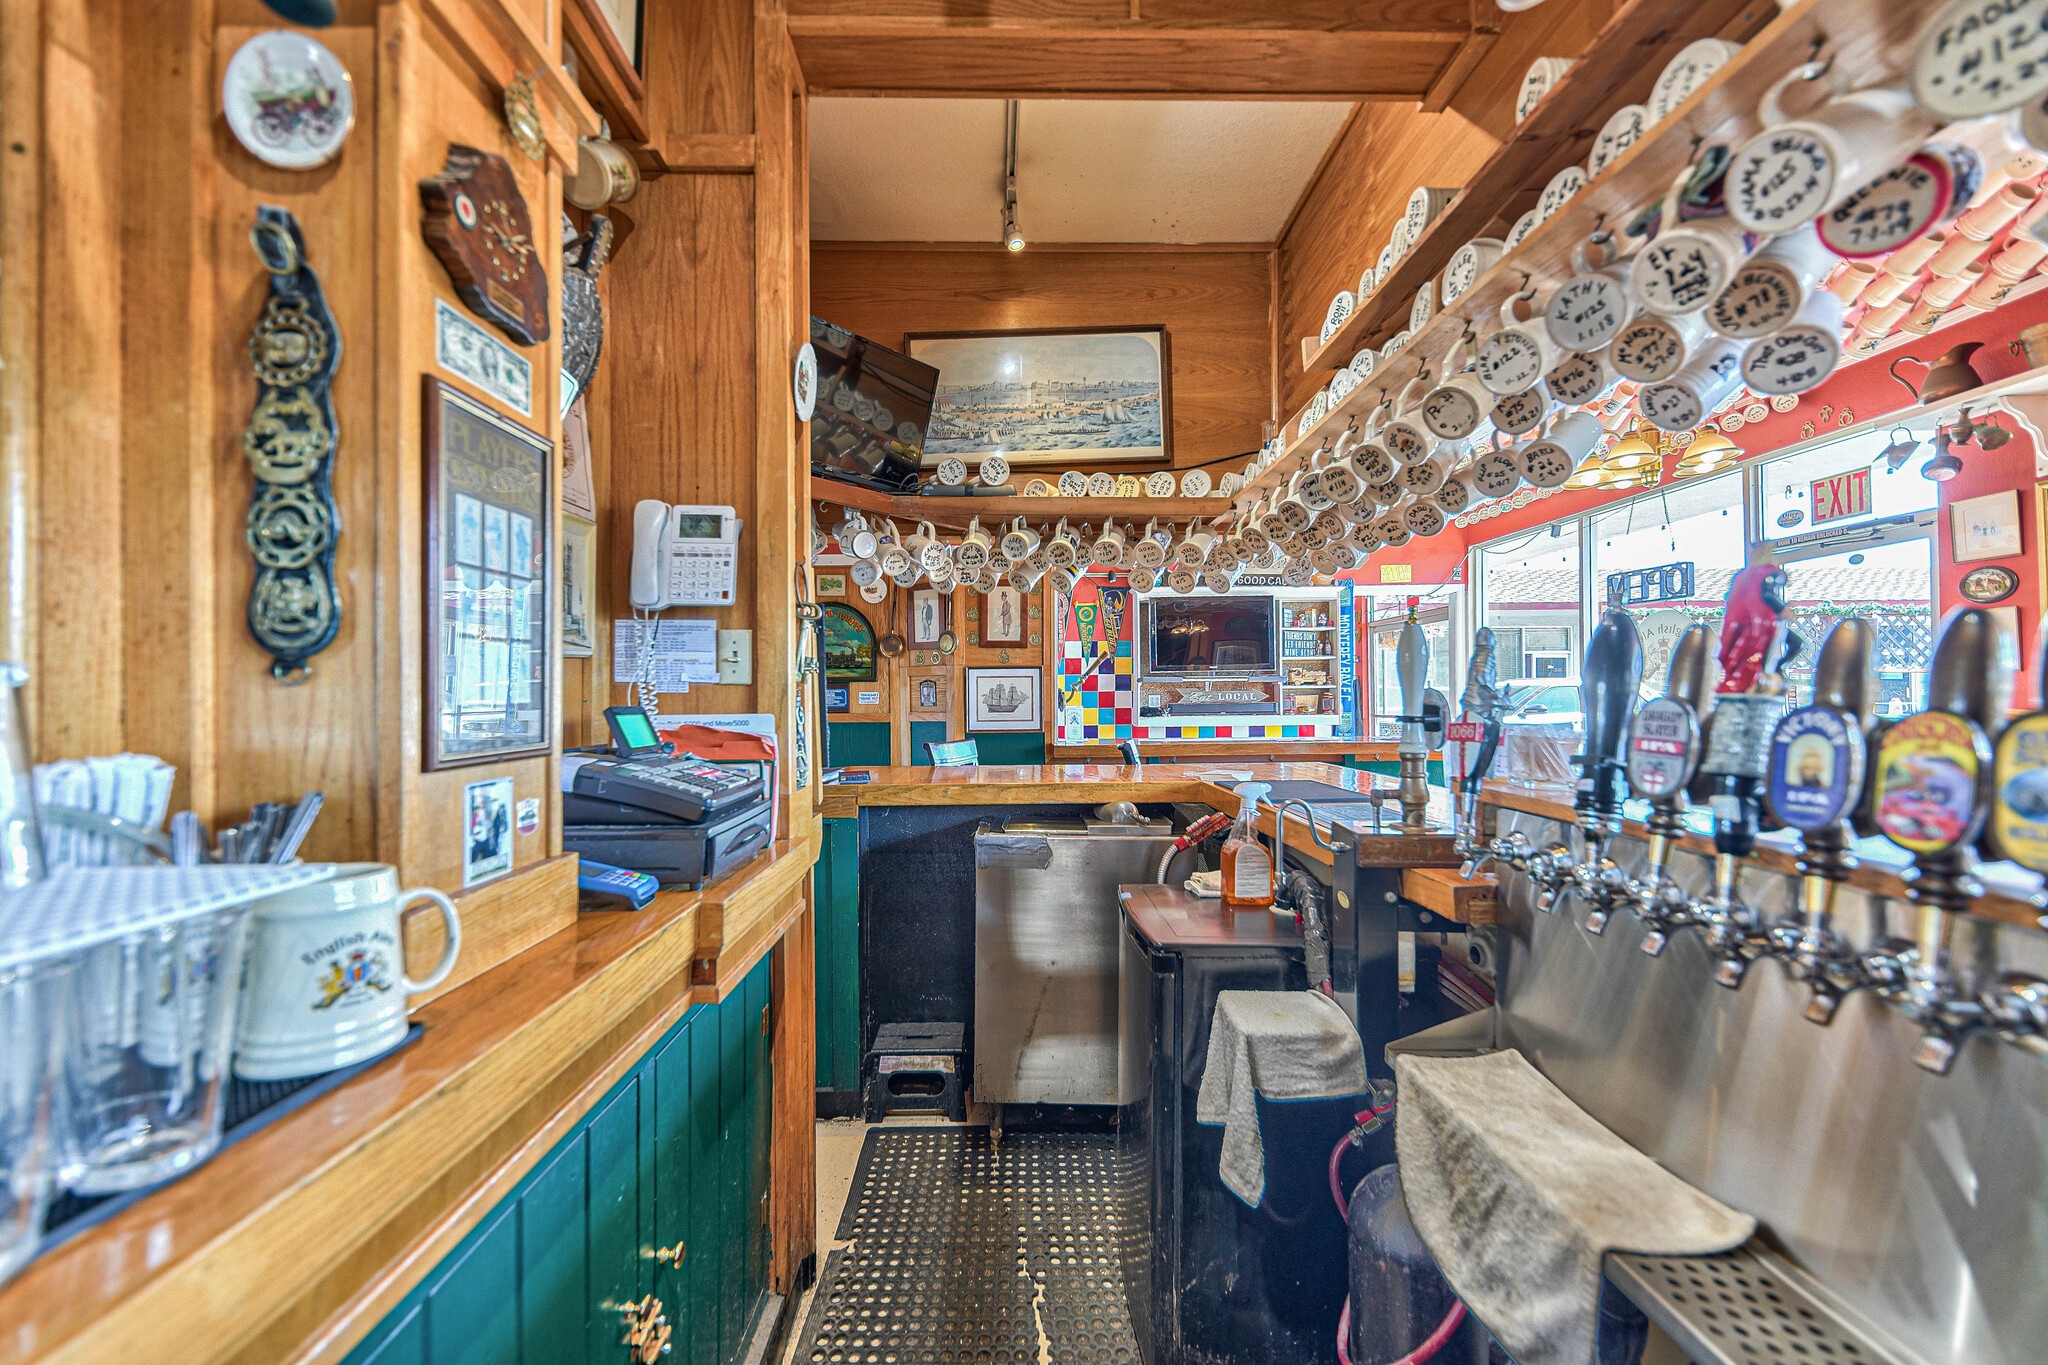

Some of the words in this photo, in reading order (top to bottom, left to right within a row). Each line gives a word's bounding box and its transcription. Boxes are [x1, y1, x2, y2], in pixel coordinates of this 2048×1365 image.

[1555, 279, 1607, 322] KATHY
[1505, 403, 1525, 419] #75
[1813, 470, 1868, 520] EXIT
[1777, 539, 1791, 547] DOOR
[1797, 534, 1816, 544] REMAIN
[1816, 530, 1842, 541] UNLOCKED
[1237, 576, 1266, 586] GOOD
[1284, 631, 1303, 640] FRIENDS
[1284, 640, 1294, 648] LET
[1285, 648, 1298, 657] WINE
[1190, 691, 1212, 702] Eat
[1218, 691, 1256, 701] LOCAL
[715, 719, 750, 727] Move/5000
[1776, 711, 1848, 745] VICTORY
[1449, 724, 1475, 739] 1066
